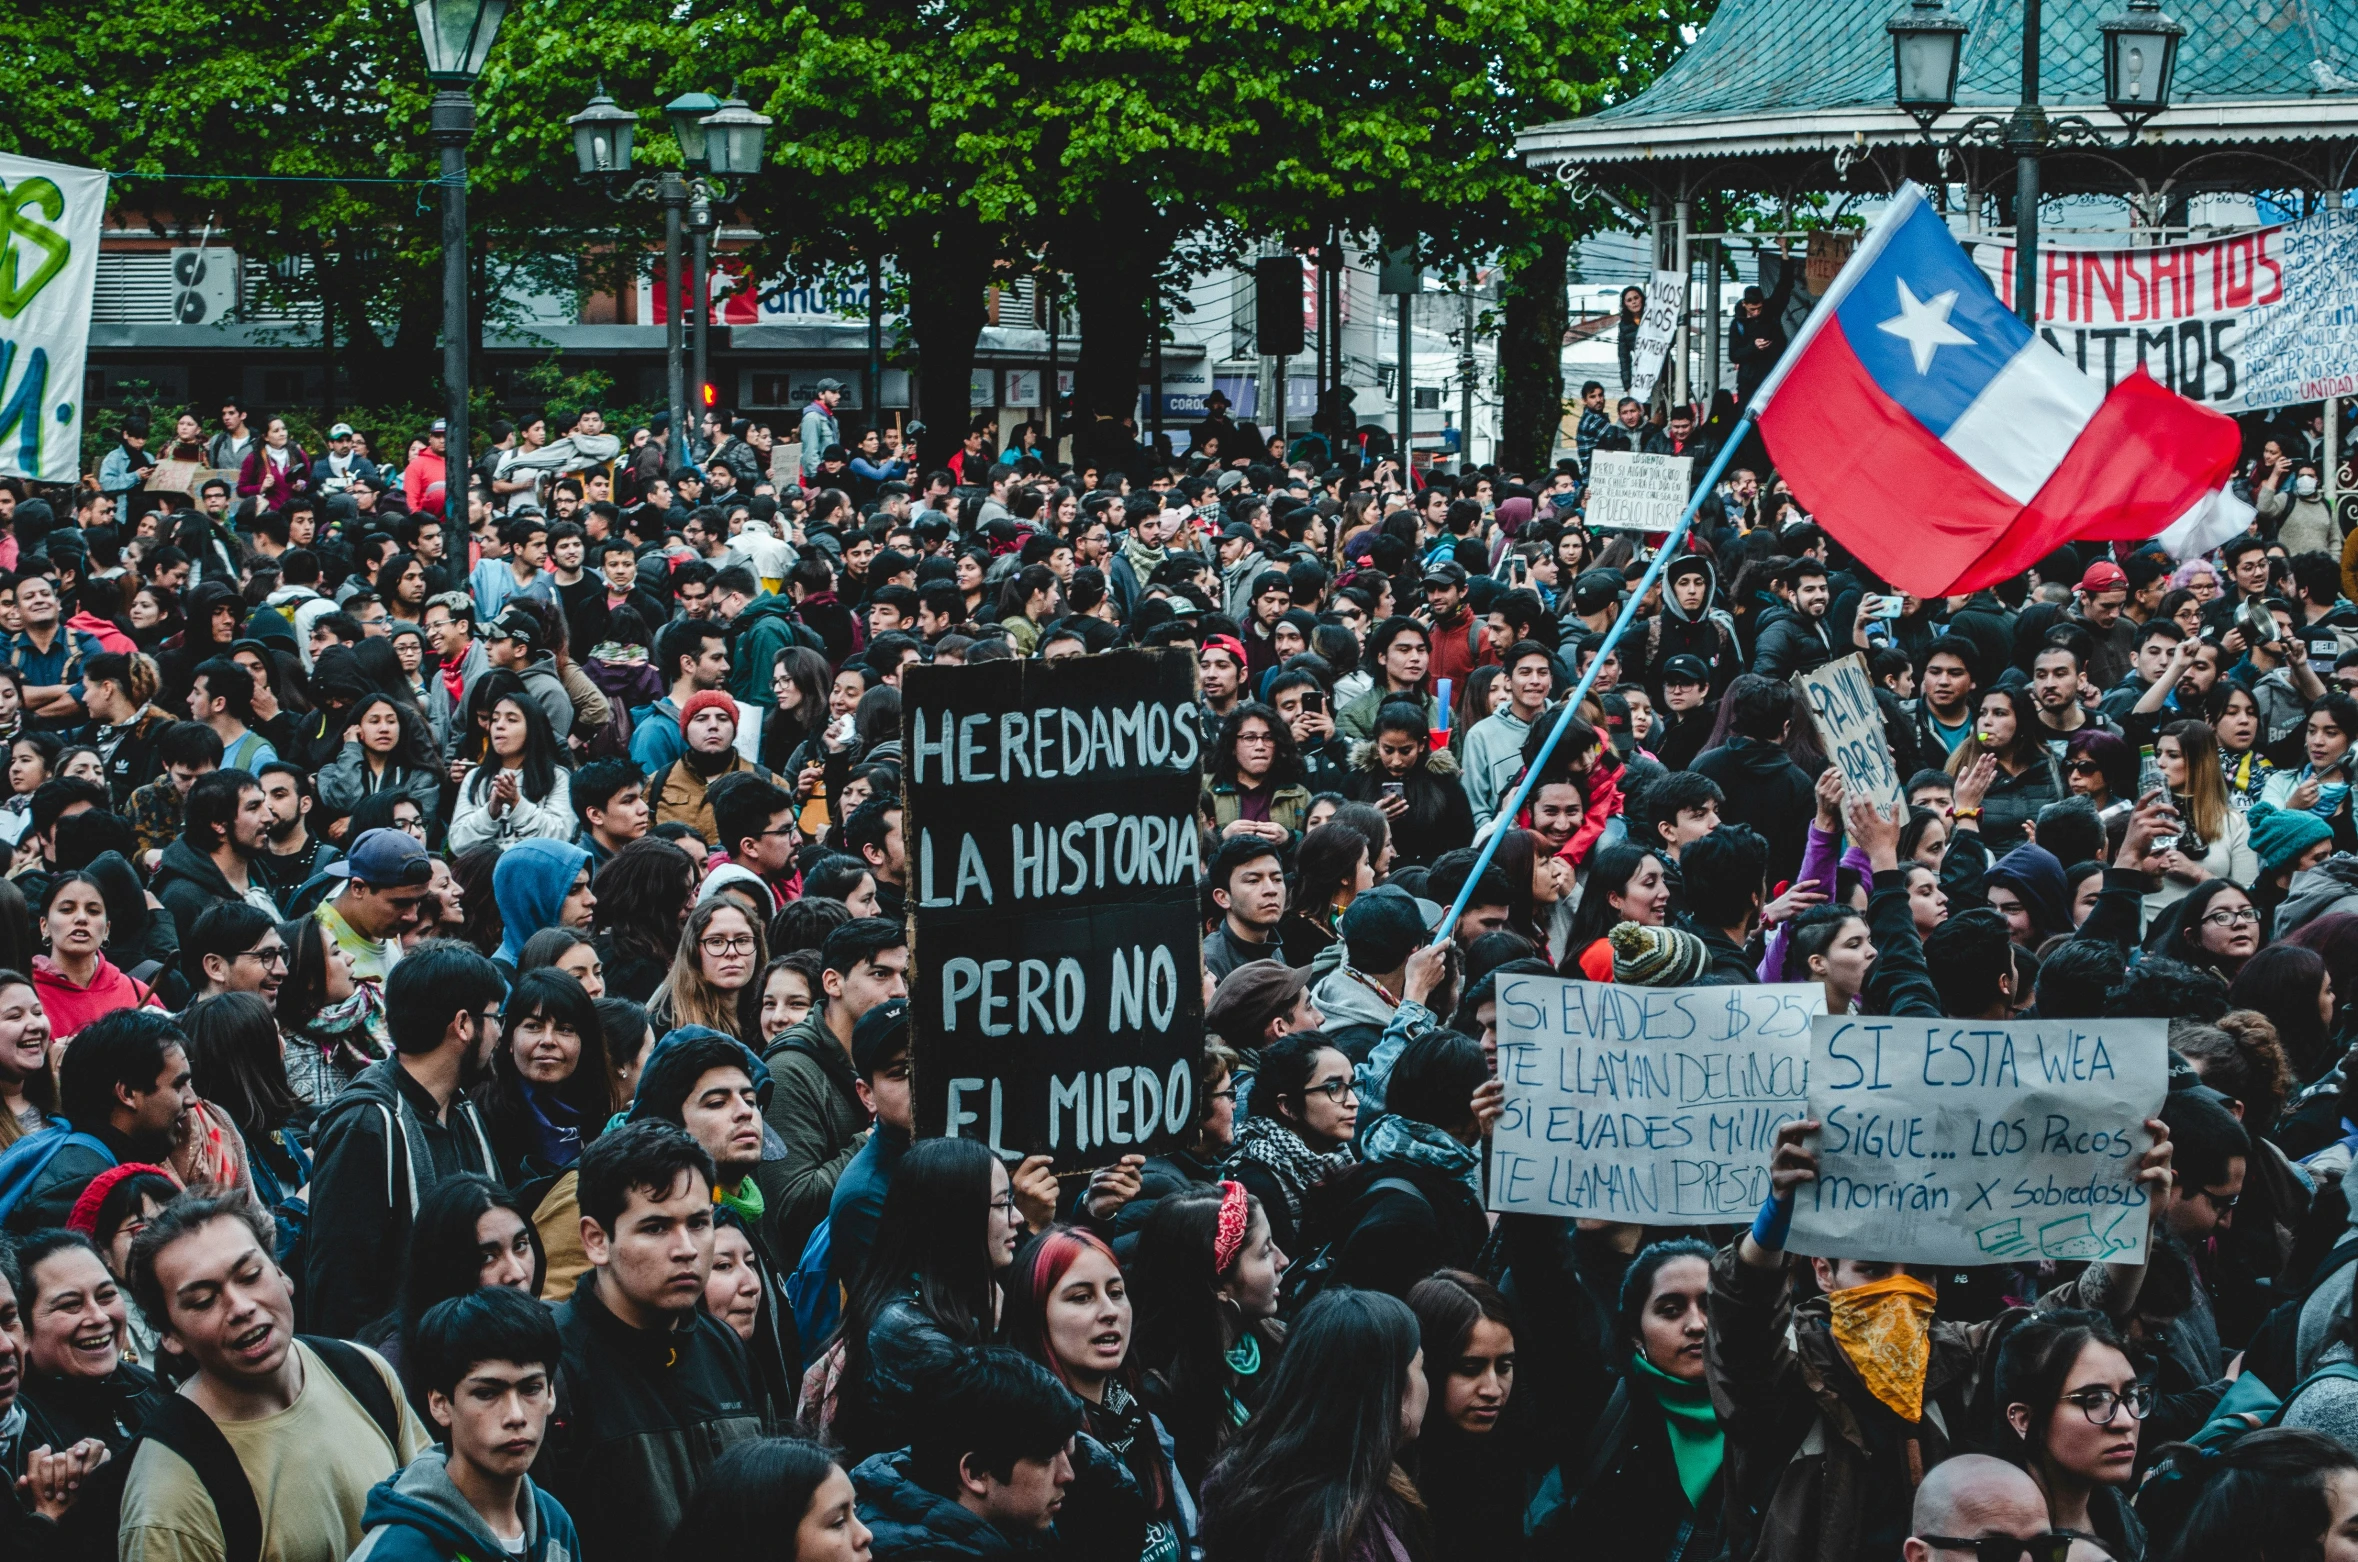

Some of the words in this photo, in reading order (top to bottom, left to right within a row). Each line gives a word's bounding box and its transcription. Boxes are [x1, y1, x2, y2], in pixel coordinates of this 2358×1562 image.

[1170, 398, 1207, 411] CORO
[913, 700, 1199, 786] HEREDAMOS
[918, 826, 994, 908] LA
[1011, 811, 1200, 899] HISTORIA
[942, 956, 1086, 1037] PERO
[1108, 943, 1178, 1034] NO
[1561, 984, 1697, 1042] EVADES
[1496, 1042, 1544, 1087] TE
[1559, 1046, 1672, 1102] LLAMAN
[1828, 1022, 1893, 1091] SI
[1923, 1028, 2019, 1088] ESTA
[2037, 1029, 2116, 1084] WEA
[945, 1076, 1025, 1162] EL
[1048, 1057, 1192, 1153] MIEDO
[1546, 1105, 1694, 1151] EVADES
[1970, 1117, 2028, 1157] LOS
[1495, 1150, 1539, 1205] TE
[1548, 1155, 1659, 1214] LLAMAN
